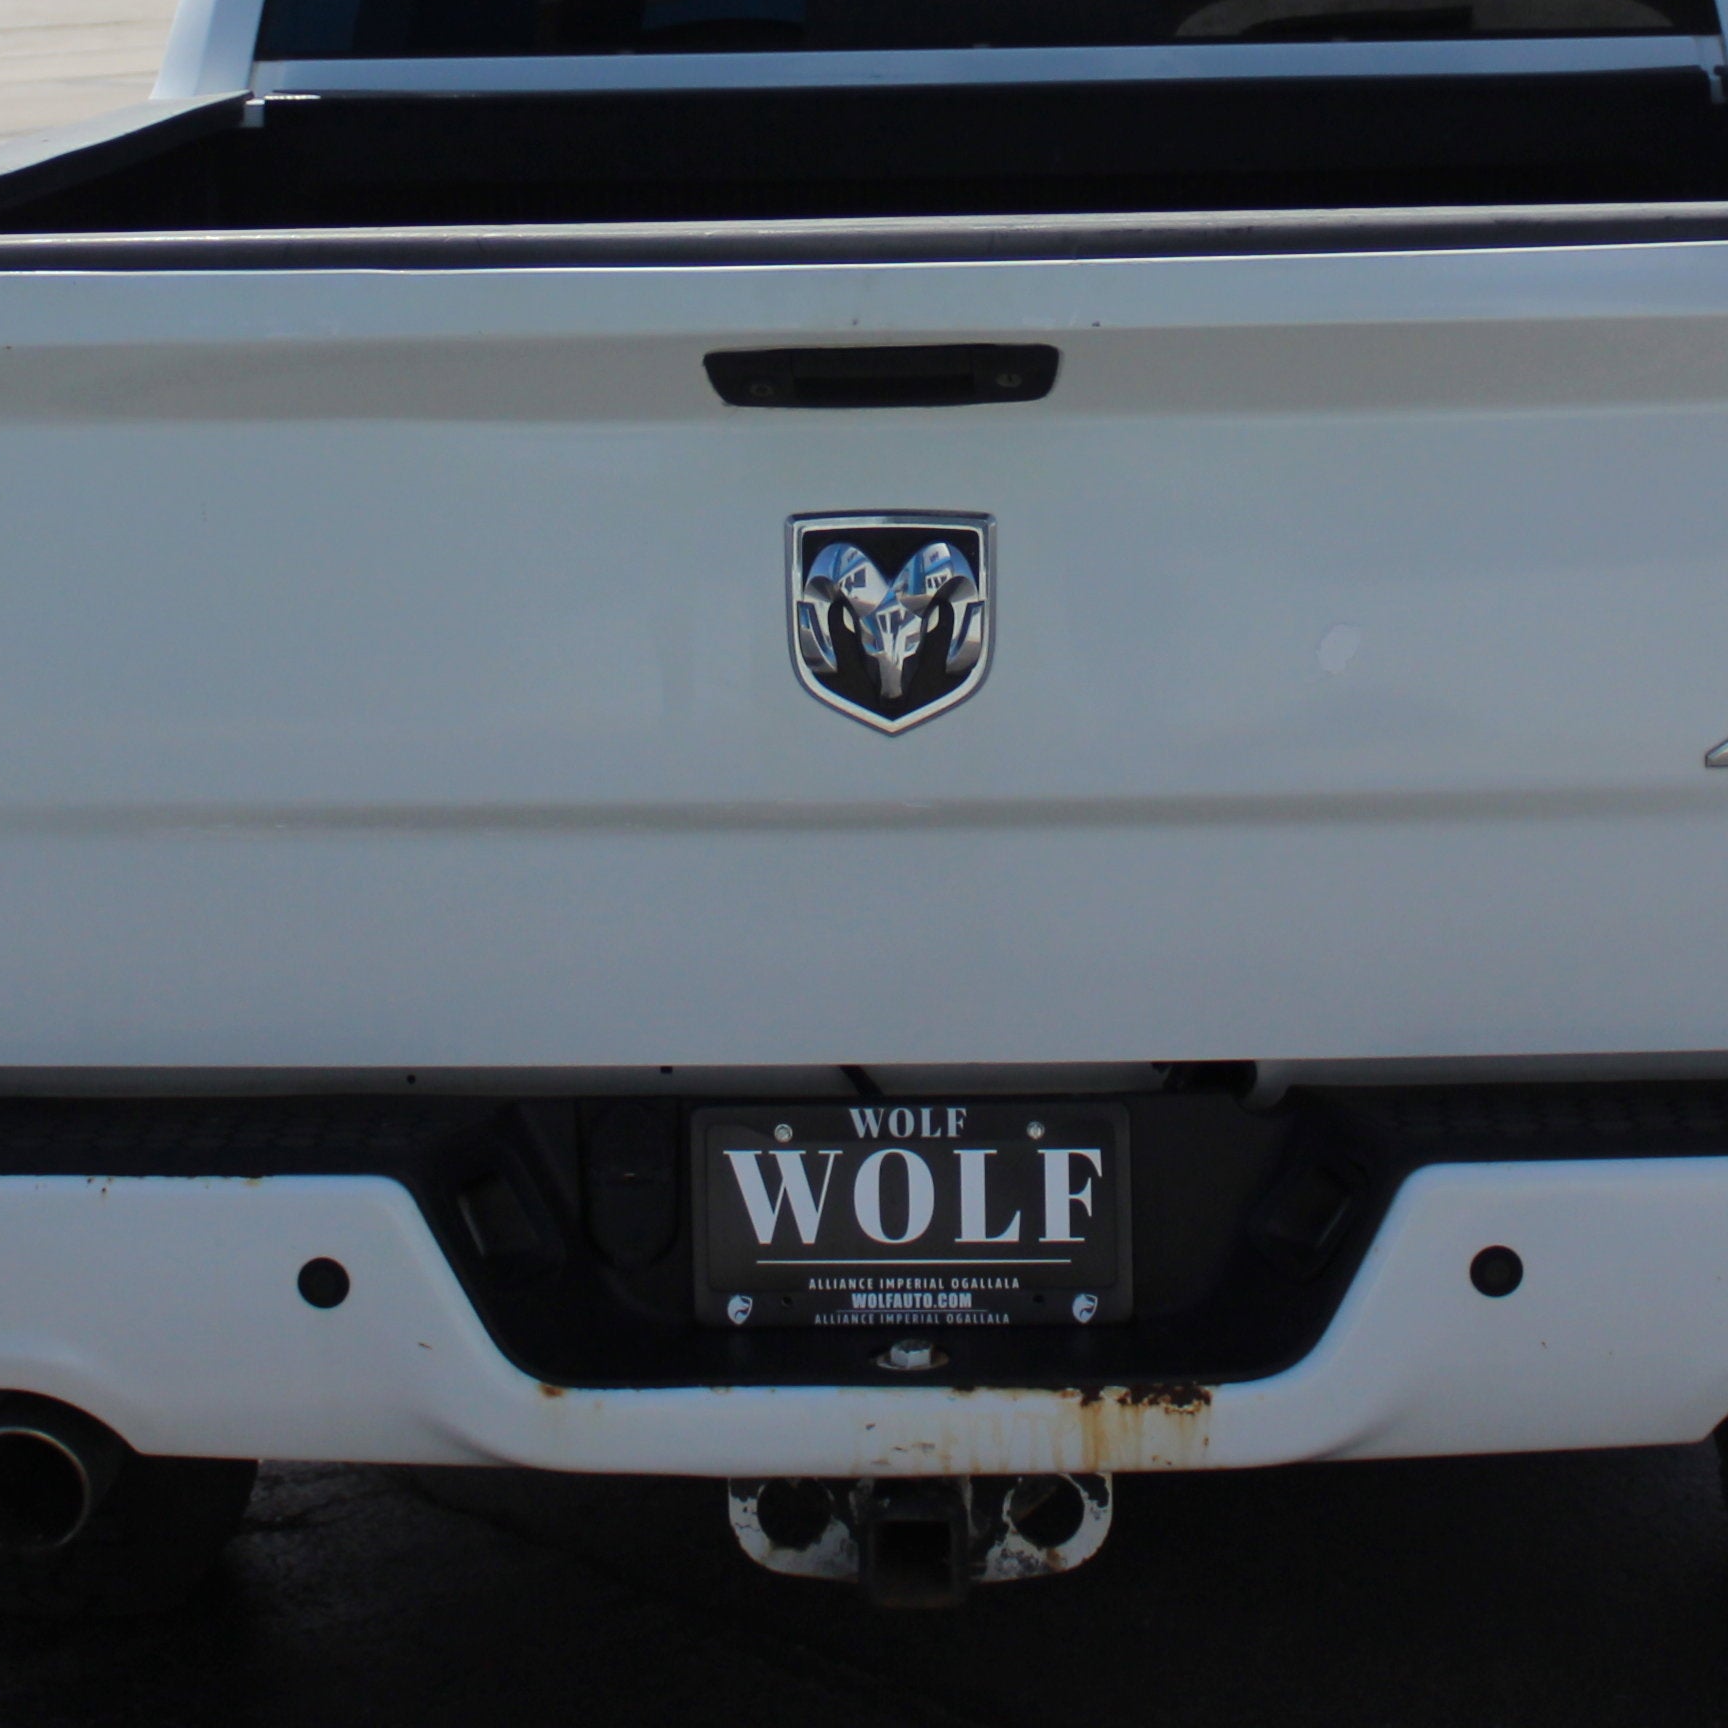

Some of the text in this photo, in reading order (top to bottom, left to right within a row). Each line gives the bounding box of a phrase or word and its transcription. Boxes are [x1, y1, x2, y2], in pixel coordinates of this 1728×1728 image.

[849, 1107, 968, 1138] WOLF
[723, 1148, 1103, 1245] WOLF
[808, 1277, 1020, 1290] ALLIANCE IMPERIAL OGALLALA
[851, 1293, 972, 1309] WOLFAUTO.COM
[814, 1313, 1010, 1325] ALLIANCE IMPERIAL OGALLALA
